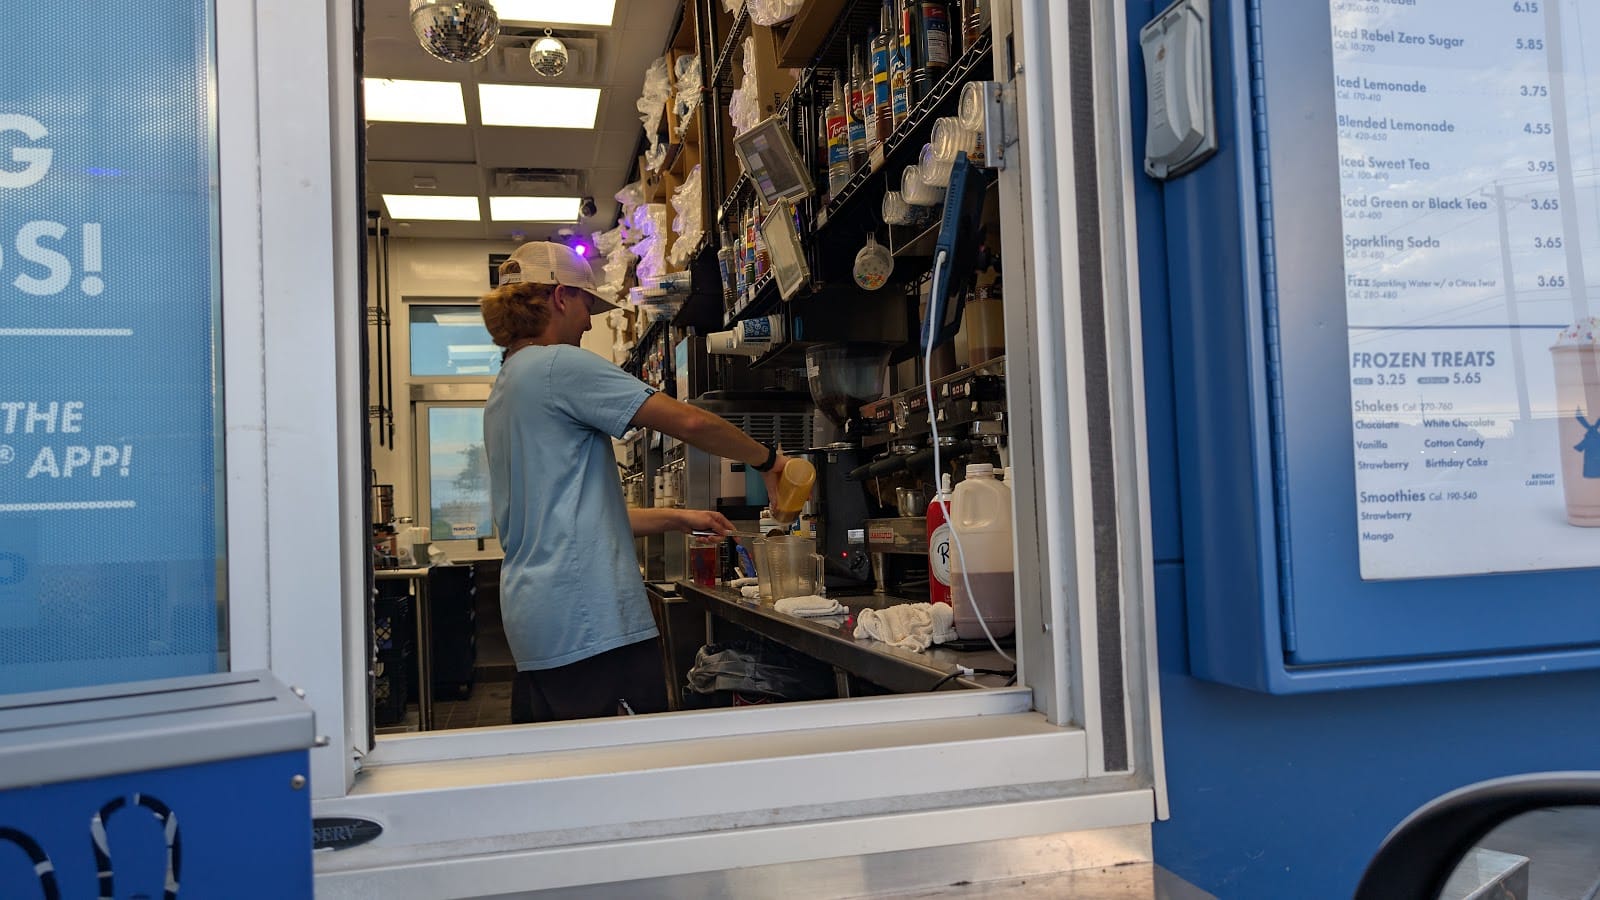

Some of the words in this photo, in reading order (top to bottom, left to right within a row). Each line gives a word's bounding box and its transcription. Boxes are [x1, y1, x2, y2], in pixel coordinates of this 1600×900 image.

[1513, 2, 1538, 13] 6.15
[1334, 26, 1358, 39] Iced
[1361, 29, 1395, 43] Rebel
[1397, 32, 1426, 45] Zero
[1428, 34, 1465, 49] Sugar
[1515, 39, 1543, 50] 5.85
[1336, 75, 1361, 89] Iced
[1363, 77, 1427, 93] Lemonade
[1520, 86, 1547, 97] 3.75
[1338, 115, 1387, 130] Blended
[1390, 119, 1455, 133] Lemonade
[1523, 123, 1551, 135] 4.55
[1341, 156, 1365, 168] Iced
[1368, 157, 1406, 170] Sweet
[1408, 158, 1430, 171] Tea
[1527, 161, 1555, 172] 3.95
[1343, 195, 1367, 208] Iced
[1370, 197, 1409, 209] Green
[1411, 200, 1426, 210] or
[1428, 198, 1463, 211] Black
[1465, 198, 1488, 211] Tea
[1531, 199, 1559, 211] 3.65
[1345, 235, 1405, 251] Sparkling
[1407, 236, 1440, 248] Soda
[1534, 237, 1562, 249] 3.65
[0, 219, 105, 296] S!
[1372, 279, 1407, 290] Sparkling
[1408, 279, 1432, 288] Water
[1455, 279, 1477, 288] Citrus
[1537, 276, 1565, 288] 3.65
[1352, 351, 1426, 369] FROZEN
[1432, 350, 1495, 368] TREATS
[1377, 373, 1406, 385] 3.25
[1453, 372, 1481, 385] 5.65
[1354, 400, 1399, 413] Shakes
[1, 401, 84, 433] THE
[1355, 420, 1399, 430] Chocolate
[1423, 418, 1450, 429] White
[1452, 419, 1495, 429] Chocolate
[1356, 440, 1388, 450] Vanilla
[1424, 439, 1454, 449] Cotton
[1456, 438, 1485, 449] Candy
[26, 445, 133, 478] APP!
[1358, 460, 1409, 471] Strawberry
[1425, 458, 1464, 469] Birthday
[1466, 457, 1488, 468] Cake
[1360, 489, 1426, 503] Smoothies
[1447, 491, 1477, 500] 190-540
[1361, 510, 1412, 522] Strawberry
[1362, 531, 1394, 543] Mango
